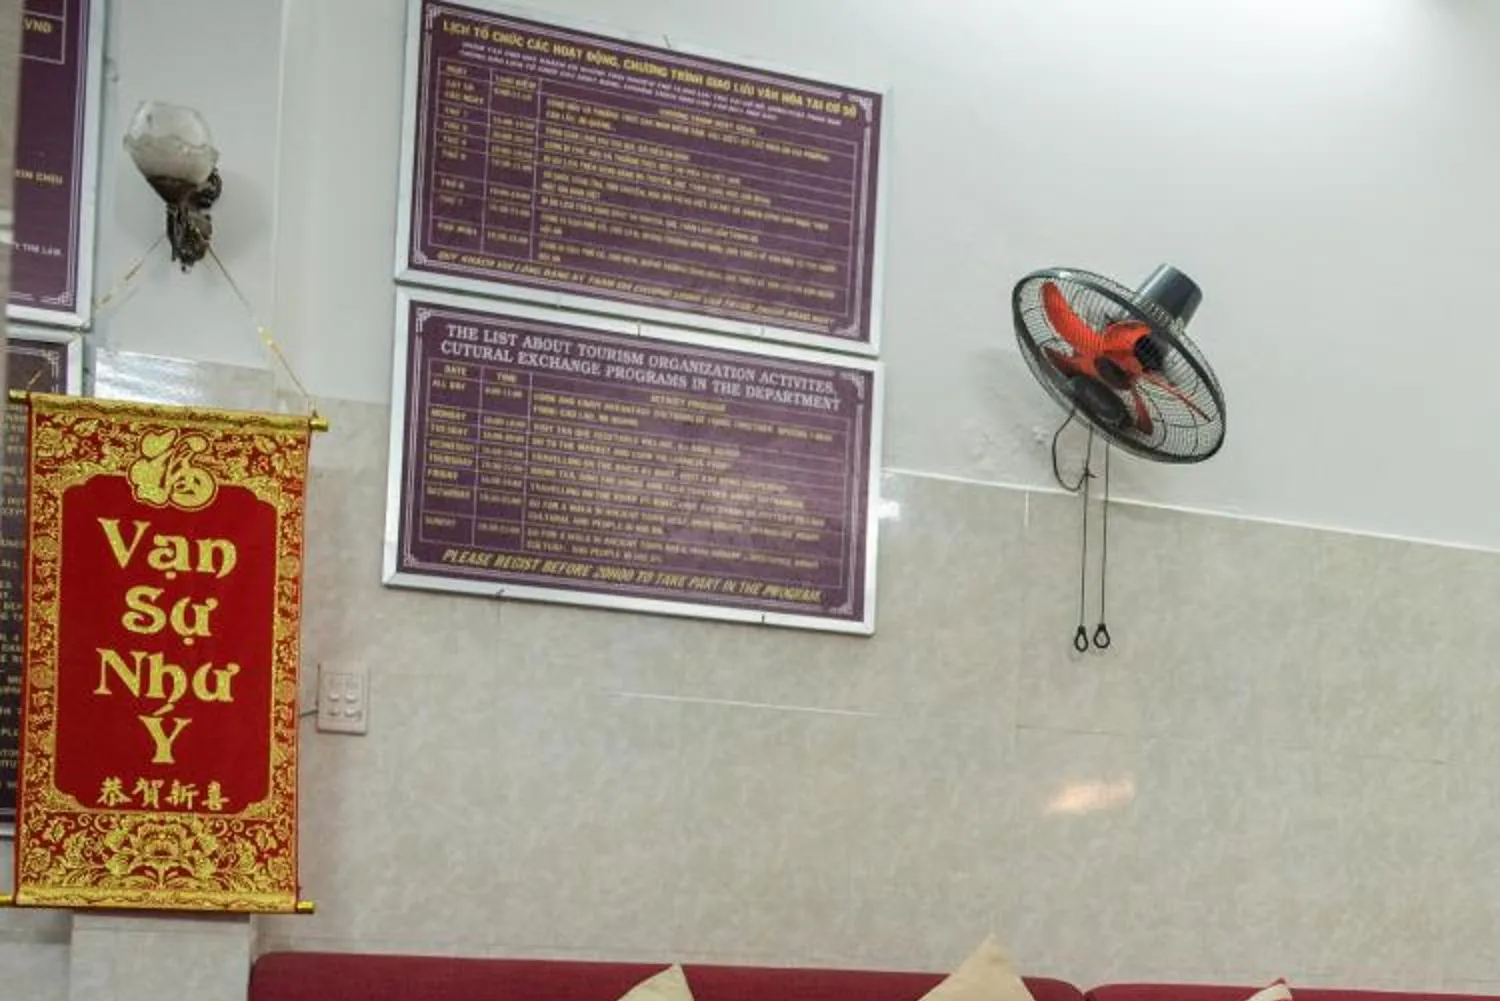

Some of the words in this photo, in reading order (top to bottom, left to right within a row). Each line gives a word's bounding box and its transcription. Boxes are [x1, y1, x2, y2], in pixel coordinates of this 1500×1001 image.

[441, 339, 514, 363] CUTURAL
[517, 351, 601, 375] EXCHANGE
[605, 364, 687, 389] PROGRAMS
[692, 377, 708, 390] IN
[712, 379, 741, 396] THE
[745, 384, 841, 411] DEPARTMENT
[446, 323, 479, 341] THE
[483, 329, 518, 346] LIST
[522, 335, 573, 355] ABOUT
[577, 343, 644, 365] TOURISM
[649, 354, 755, 381] ORGANIZATION
[98, 516, 238, 580] Vạn
[442, 549, 494, 566] PLEASE
[121, 585, 218, 646] Sự
[95, 648, 241, 704] Như
[138, 703, 193, 765] Ý
